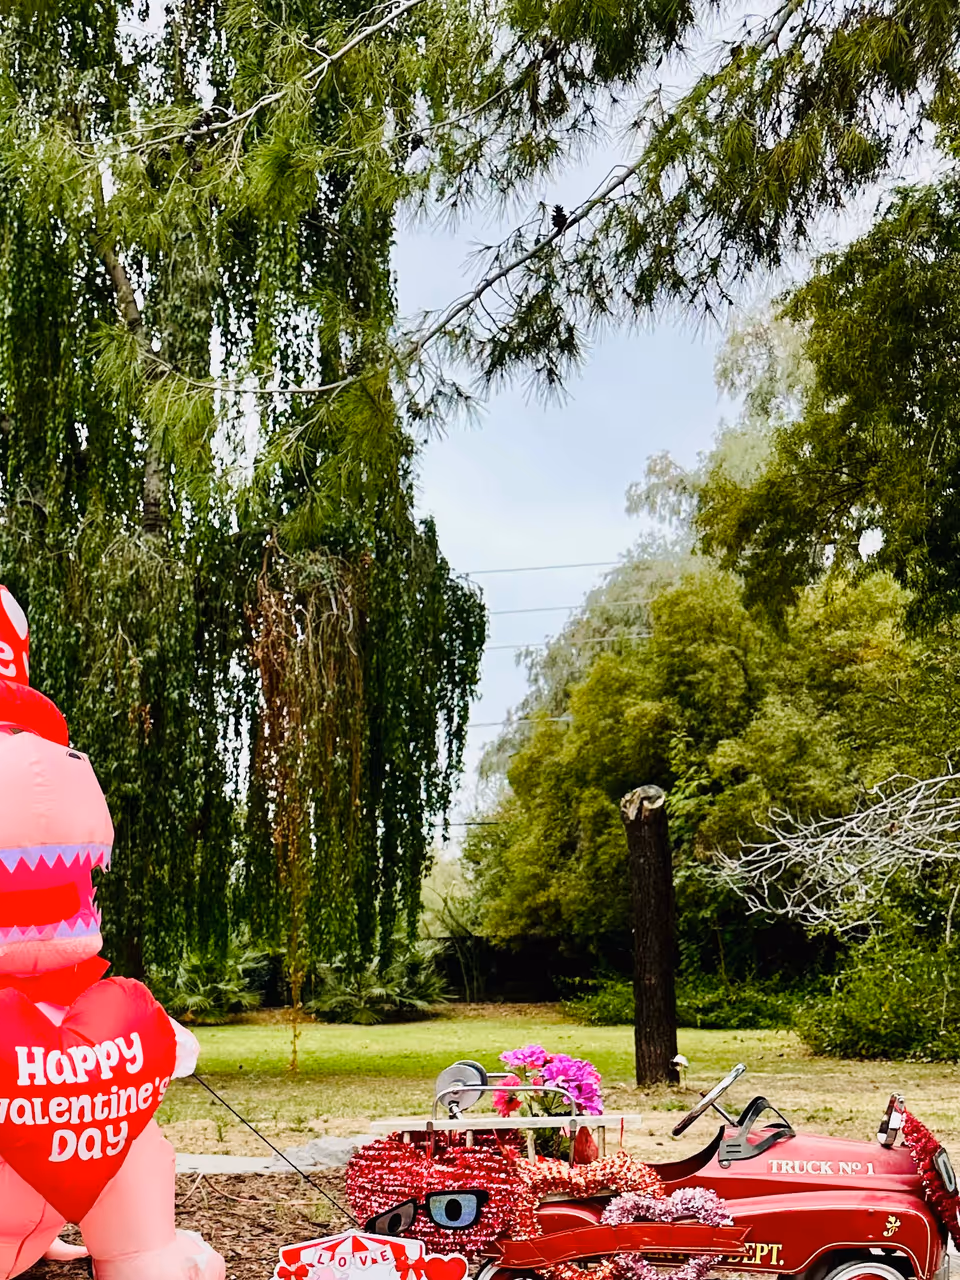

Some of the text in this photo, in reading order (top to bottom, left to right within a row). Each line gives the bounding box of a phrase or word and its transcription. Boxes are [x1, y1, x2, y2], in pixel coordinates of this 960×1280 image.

[15, 1031, 144, 1086] Happy
[768, 1160, 834, 1175] TRUCK
[866, 1162, 875, 1175] 1
[317, 1250, 390, 1267] LOVE
